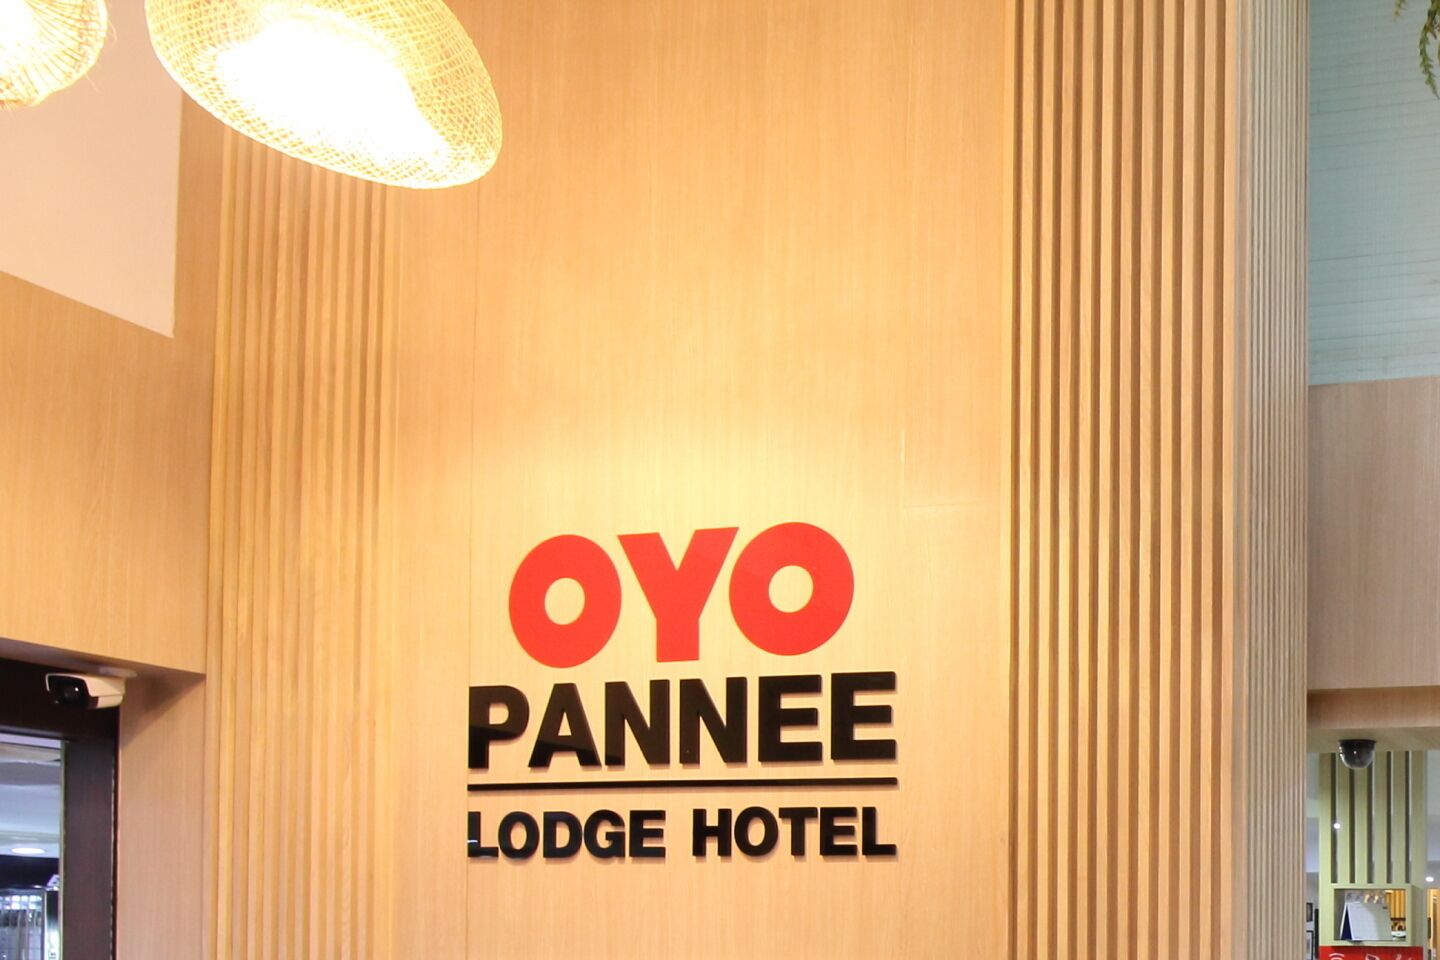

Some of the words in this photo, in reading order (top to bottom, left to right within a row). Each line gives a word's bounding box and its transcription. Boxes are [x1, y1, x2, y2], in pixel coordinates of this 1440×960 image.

[508, 521, 855, 669] OYO
[468, 671, 897, 769] PANNEE
[467, 809, 667, 860] LODGE
[692, 806, 898, 858] HOTEL
